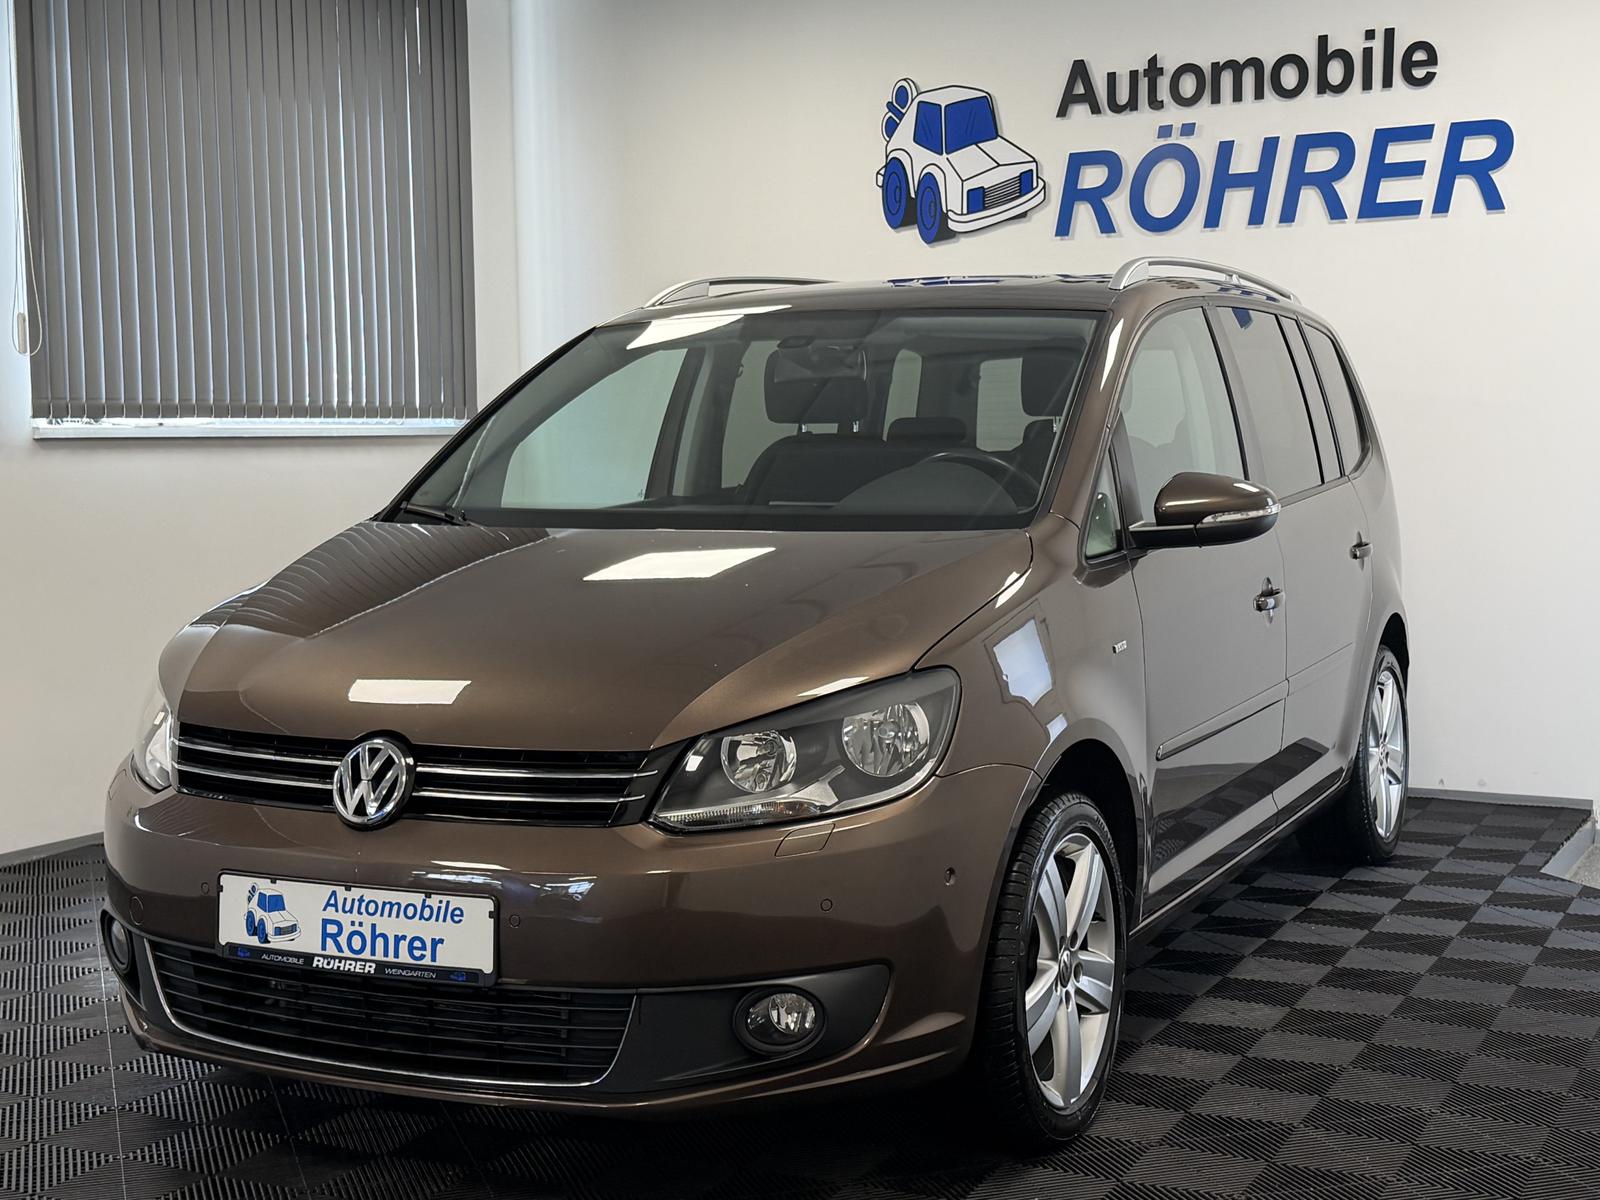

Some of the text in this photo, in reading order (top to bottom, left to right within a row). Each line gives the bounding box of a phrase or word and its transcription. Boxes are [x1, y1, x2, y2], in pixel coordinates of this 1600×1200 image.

[1056, 28, 1438, 118] Automobile
[1055, 119, 1514, 238] RÖHRER
[322, 889, 464, 924] Automobile
[320, 918, 444, 963] Röhrer
[261, 953, 304, 965] AUTOMOBILE
[384, 967, 437, 979] WEINGARTEN
